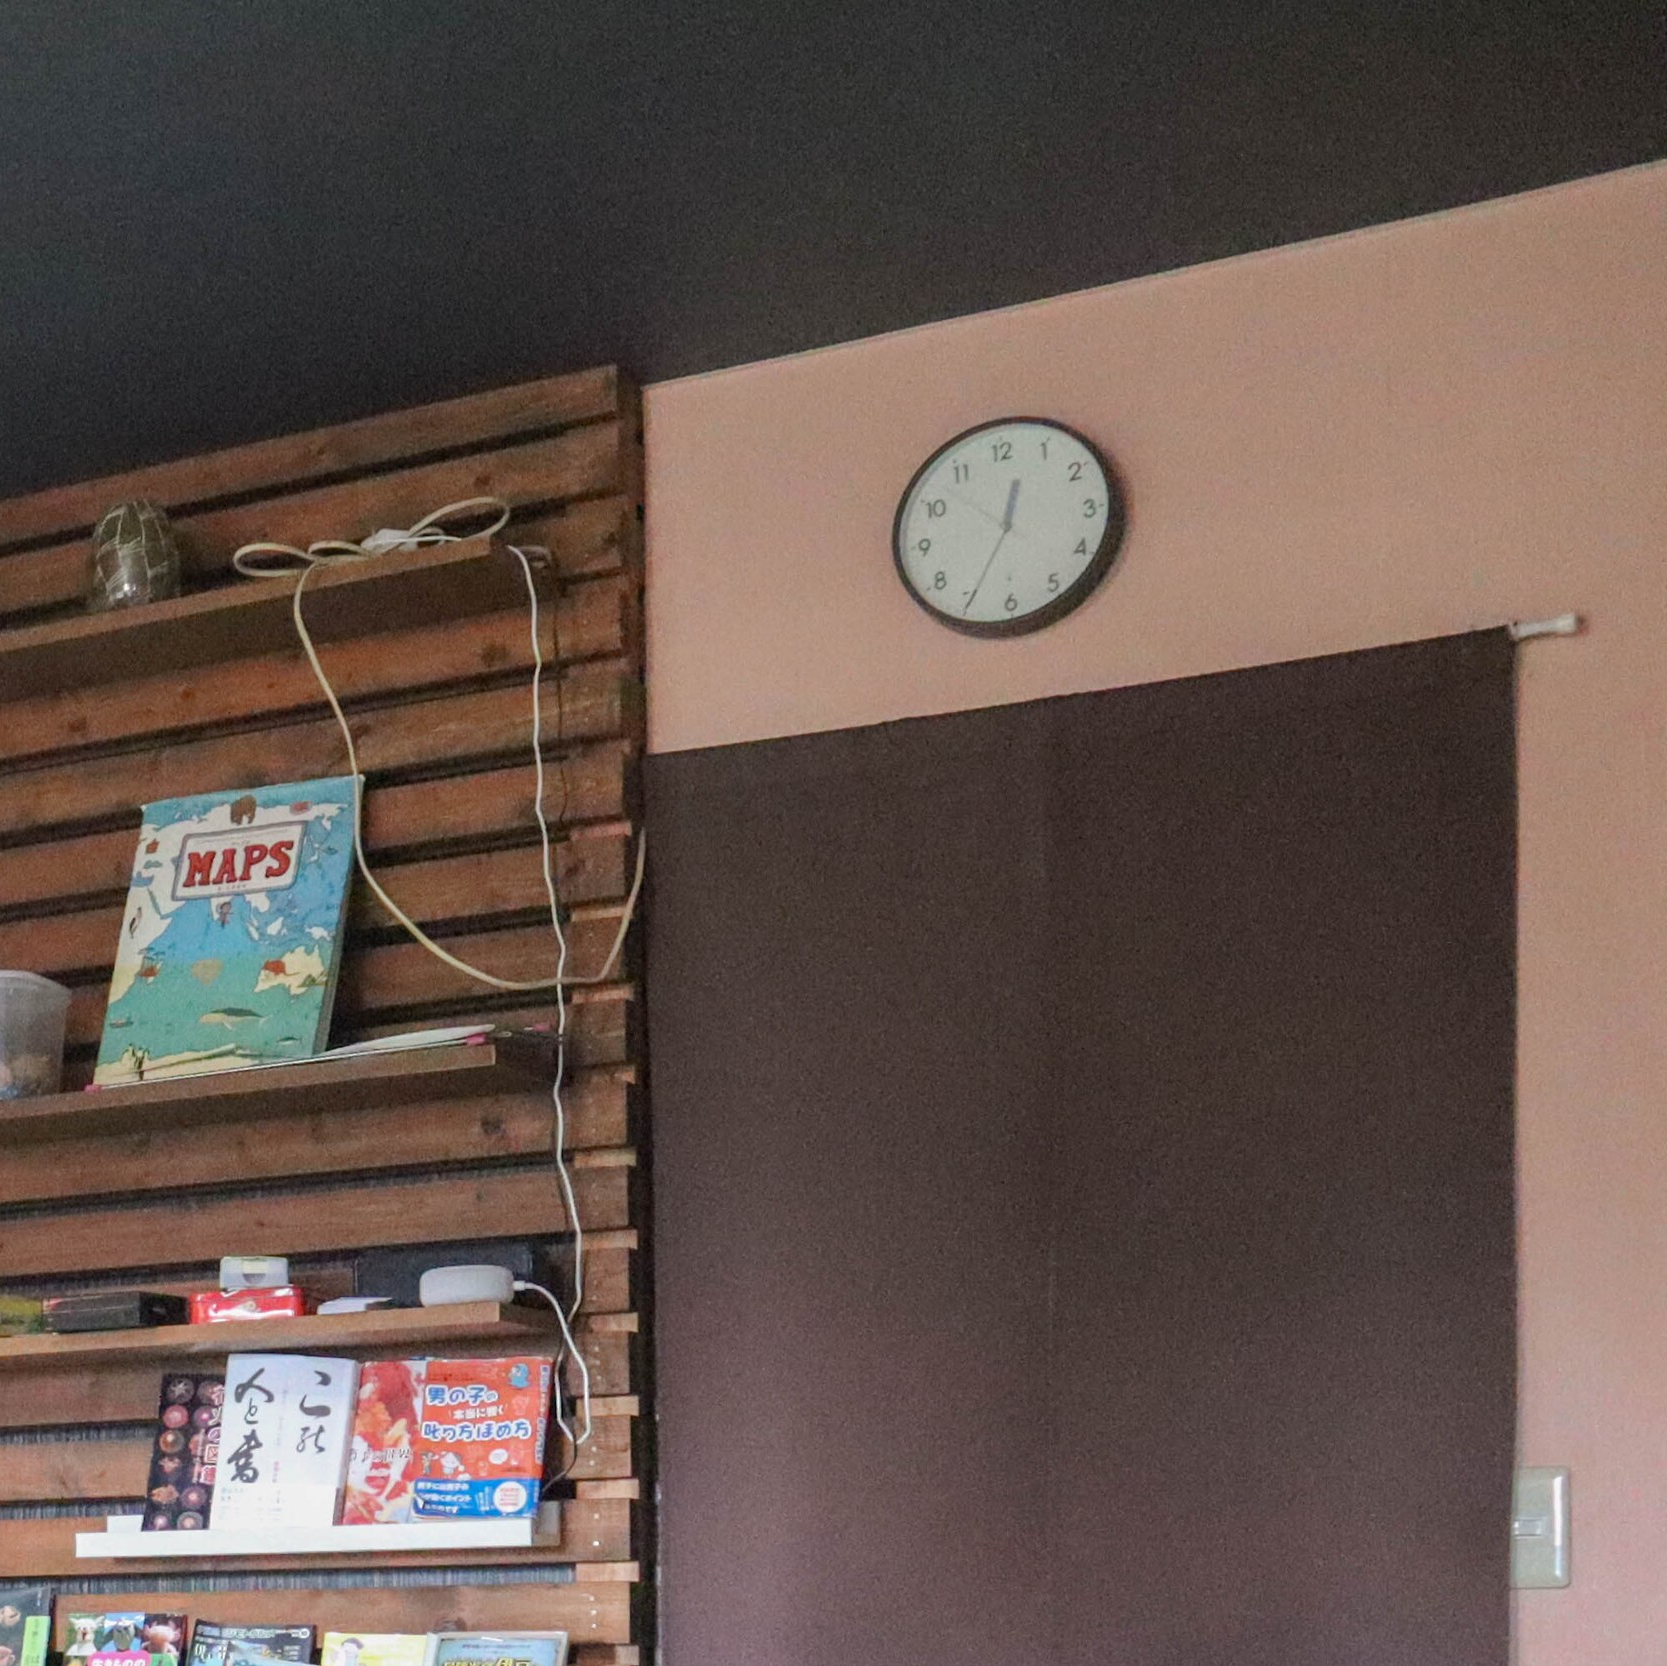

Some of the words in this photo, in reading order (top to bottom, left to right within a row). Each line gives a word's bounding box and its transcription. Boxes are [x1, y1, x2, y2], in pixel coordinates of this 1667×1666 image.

[991, 441, 1014, 463] 12
[953, 463, 969, 485] 11
[1068, 462, 1083, 482] 2
[926, 499, 946, 519] 10
[1082, 499, 1096, 518] 3
[918, 538, 931, 556] 9
[1073, 538, 1087, 556] 4
[933, 571, 947, 591] 8
[1047, 573, 1060, 593] 5
[1004, 593, 1019, 612] 6
[183, 840, 294, 888] MAPS
[425, 1385, 499, 1407] 男の子の
[421, 1419, 532, 1443] 叱り方ほめ方
